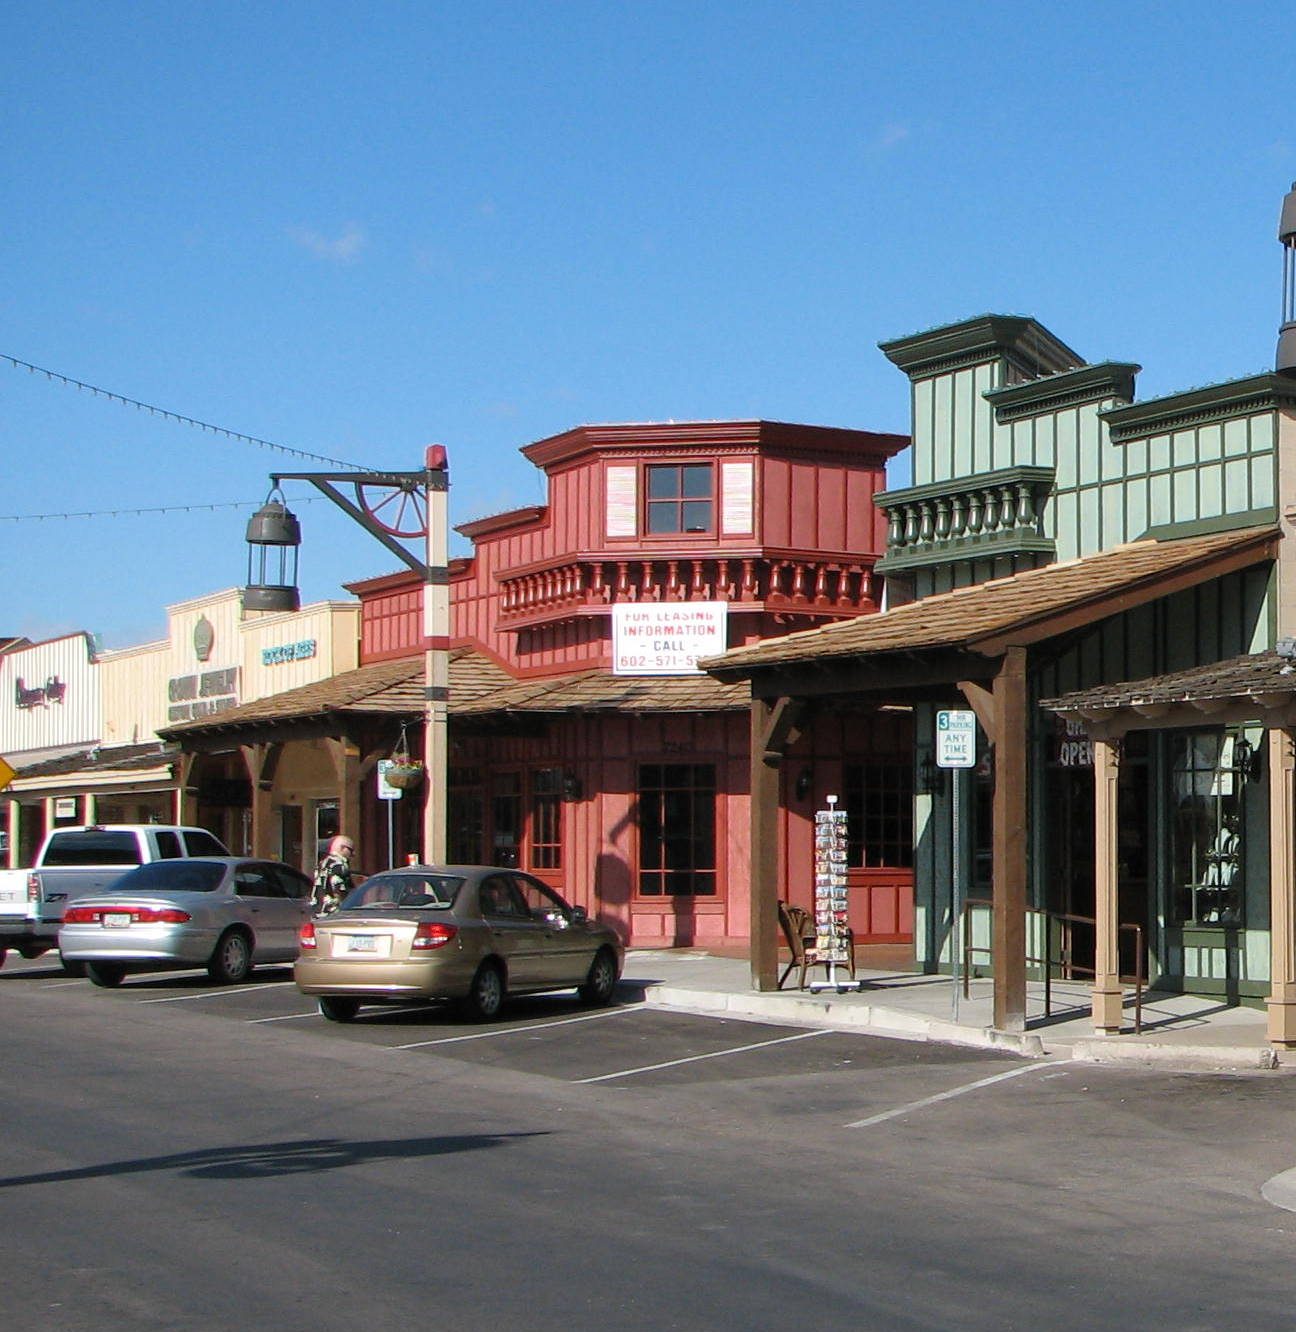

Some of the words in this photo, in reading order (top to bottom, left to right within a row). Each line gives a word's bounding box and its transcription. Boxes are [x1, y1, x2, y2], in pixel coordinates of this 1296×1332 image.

[625, 611, 649, 621] FOR
[657, 610, 714, 621] LEASING
[624, 624, 716, 636] INFORMATION
[653, 640, 686, 652] CALL
[939, 714, 949, 730] 3
[944, 734, 968, 743] ANY
[944, 744, 968, 754] TIME
